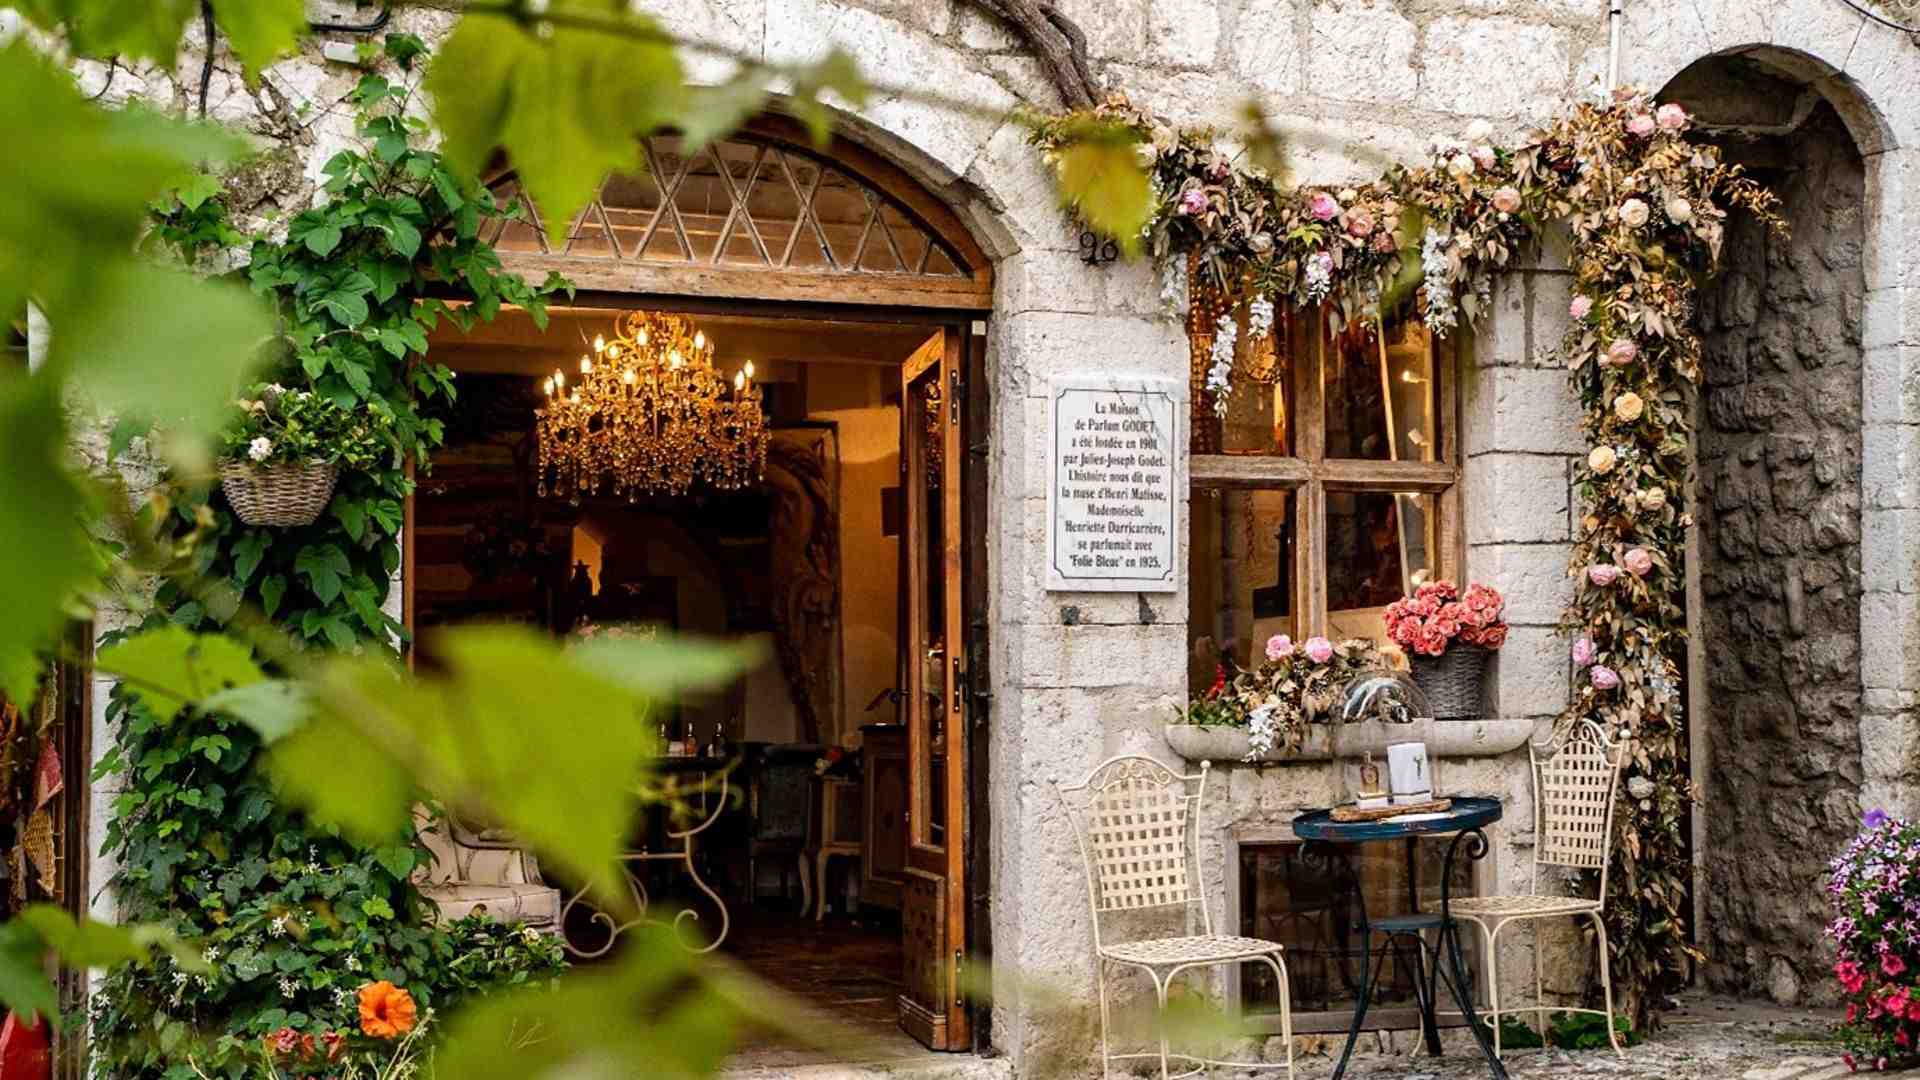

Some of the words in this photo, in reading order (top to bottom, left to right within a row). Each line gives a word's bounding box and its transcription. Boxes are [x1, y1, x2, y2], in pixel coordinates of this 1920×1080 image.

[1095, 402, 1105, 414] La
[1109, 403, 1139, 415] Maison
[1075, 419, 1085, 431] de
[1088, 418, 1120, 431] Parfum
[1122, 420, 1155, 432] GODET
[1079, 436, 1092, 447] été
[1095, 436, 1123, 448] fondée
[1126, 438, 1136, 448] en
[1063, 455, 1078, 466] par
[1138, 454, 1166, 467] Godet.
[1109, 473, 1129, 482] nous
[1131, 471, 1144, 483] dit
[1145, 474, 1161, 486] que
[1062, 487, 1070, 498] la
[1073, 489, 1094, 499] muse
[1098, 487, 1128, 500] d'Henri
[1131, 488, 1167, 501] Matisse,
[1087, 504, 1144, 517] Mademoiselle
[1065, 520, 1105, 533] Henriette
[1078, 542, 1087, 550] se
[1090, 538, 1132, 553] parfumait
[1134, 542, 1152, 551] avec
[1125, 558, 1136, 567] en
